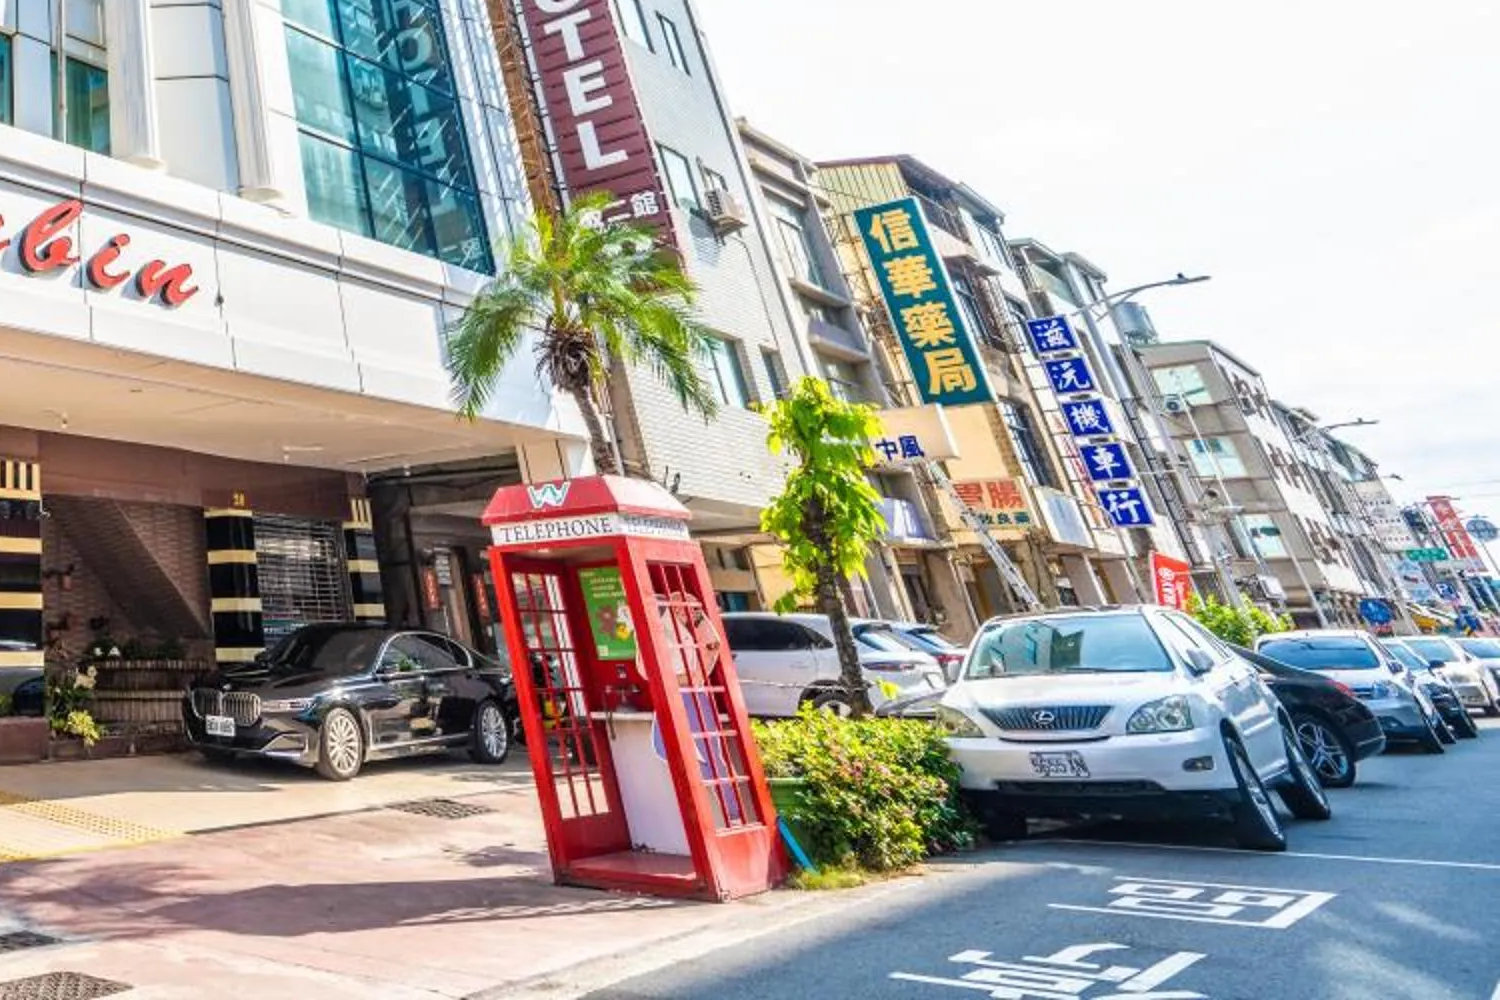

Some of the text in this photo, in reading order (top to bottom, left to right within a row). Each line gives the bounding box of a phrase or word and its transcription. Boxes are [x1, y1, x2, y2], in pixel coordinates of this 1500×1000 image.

[869, 207, 977, 396] 信華藥局
[875, 435, 925, 461] 中風
[500, 517, 613, 543] TELEPHONE
